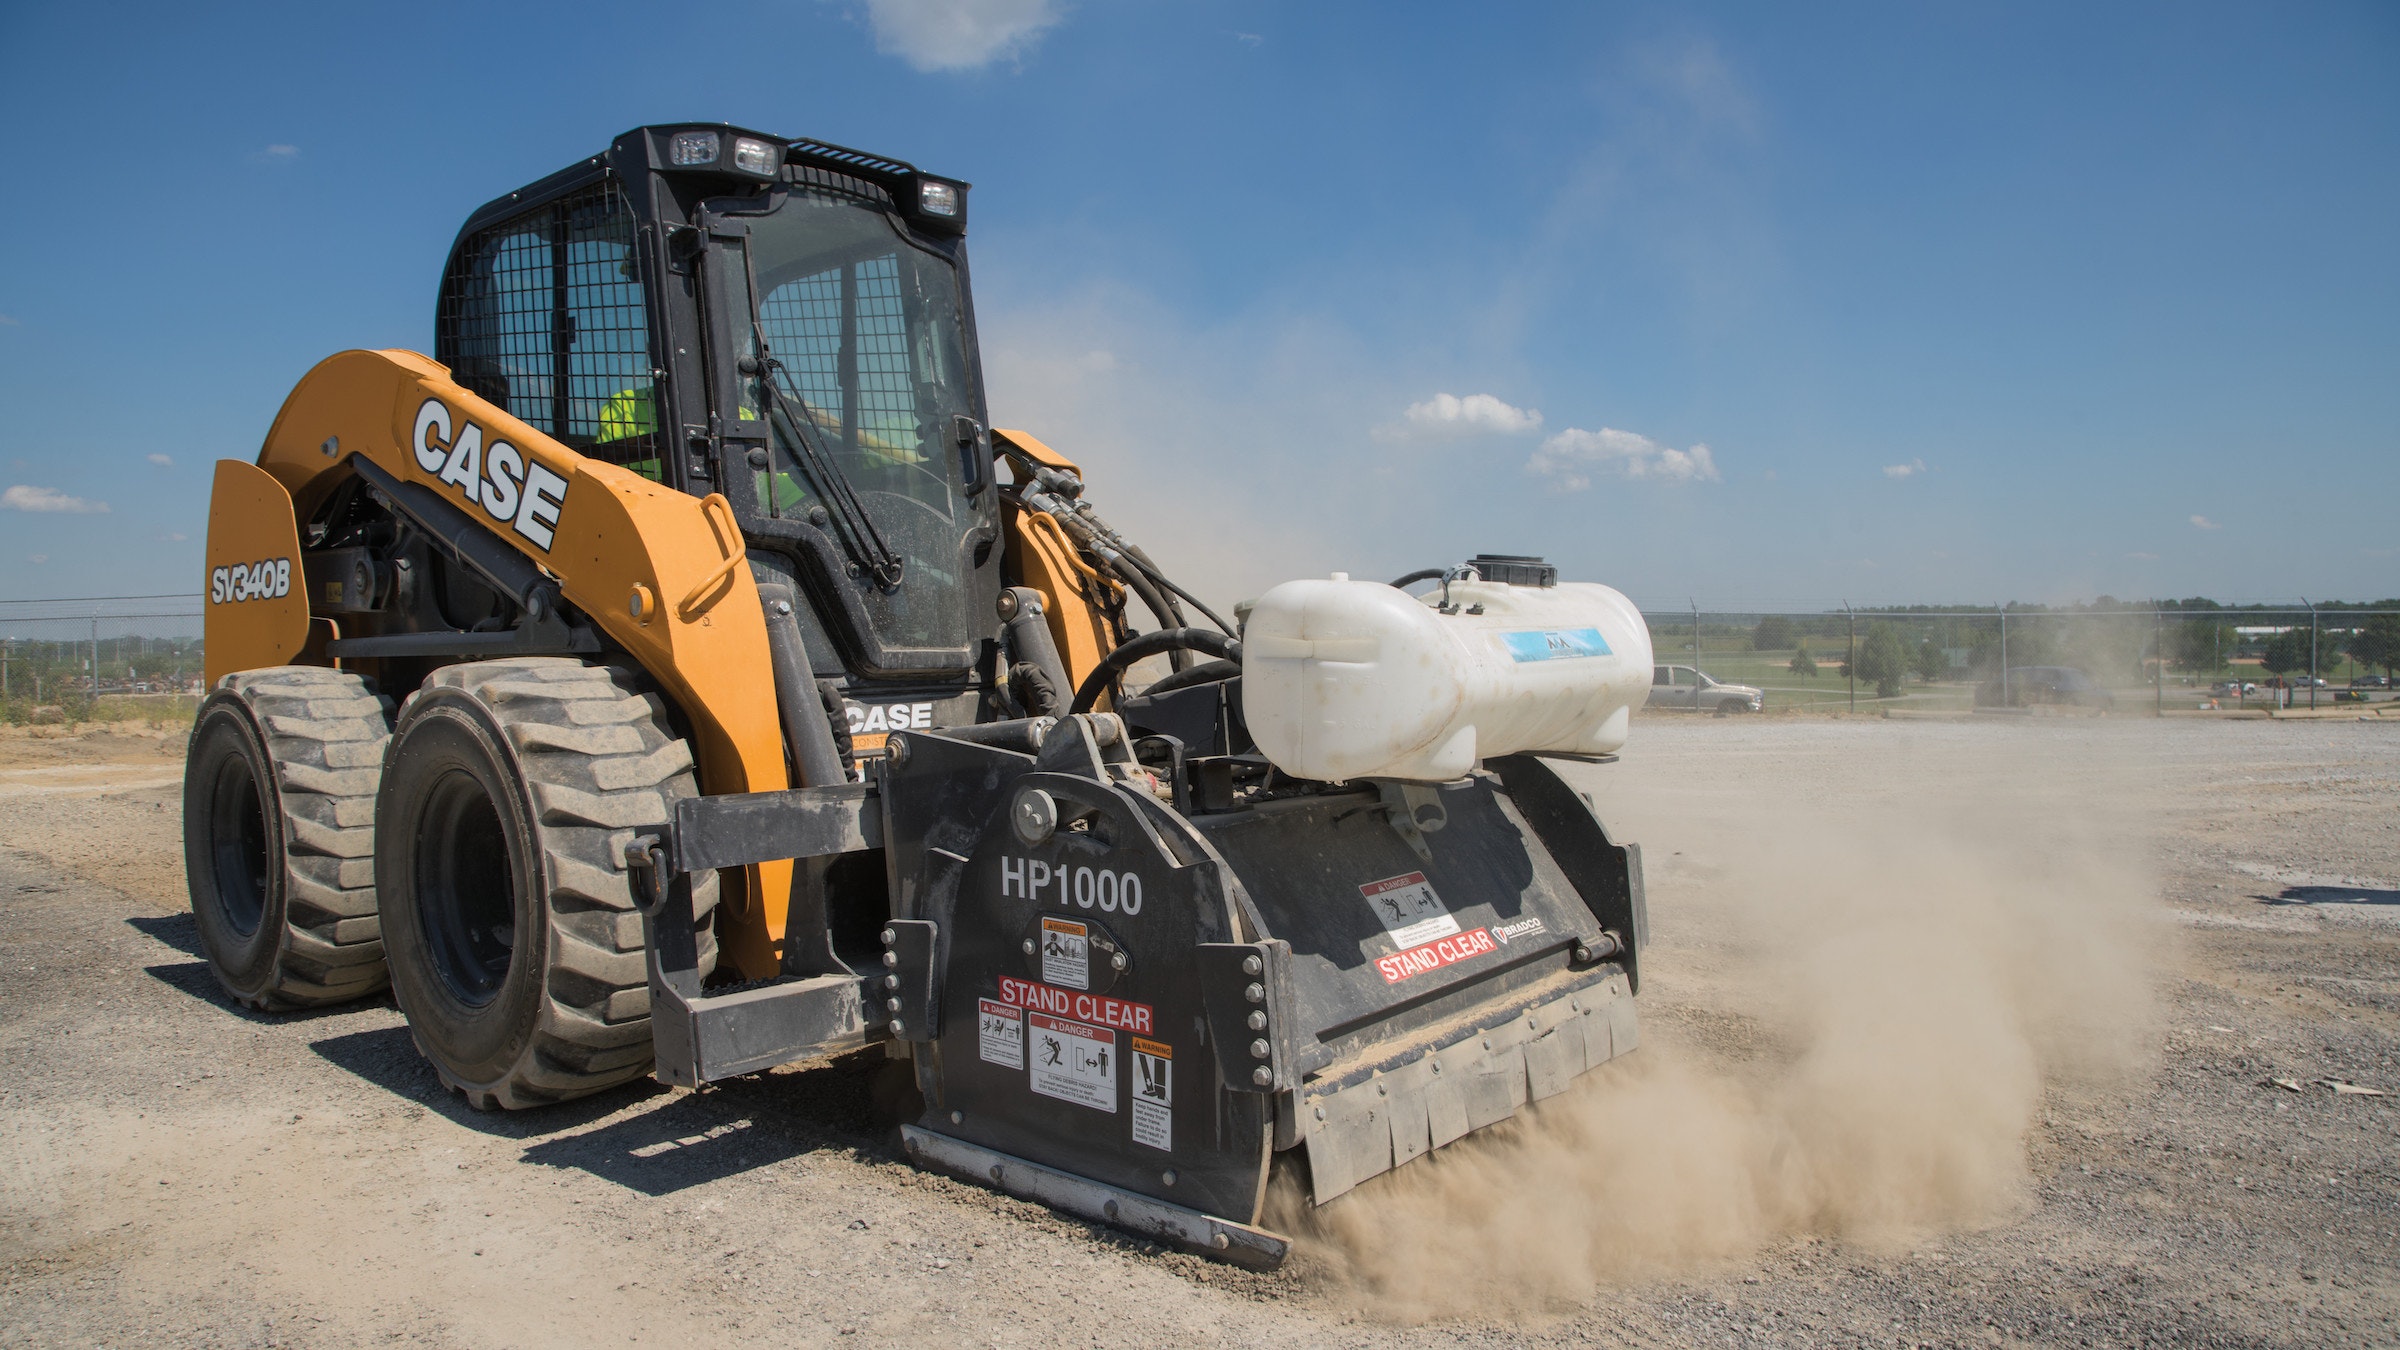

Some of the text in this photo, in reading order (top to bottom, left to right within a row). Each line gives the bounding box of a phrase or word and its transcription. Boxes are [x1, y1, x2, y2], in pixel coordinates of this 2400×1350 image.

[413, 397, 569, 554] CASE
[211, 558, 291, 605] SV340B
[845, 703, 932, 734] CASE
[853, 736, 888, 748] CONST
[1001, 856, 1143, 916] HP1000
[1383, 877, 1412, 890] DANGER
[1053, 923, 1081, 934] WARNING
[1503, 917, 1541, 936] BRADCO
[1380, 948, 1440, 980] STAND
[1438, 930, 1494, 963] CLEAR
[991, 1005, 1018, 1019] DANGER
[1002, 979, 1150, 1032] STAND CLEAR
[1059, 1022, 1094, 1038] DANGER
[1142, 1042, 1171, 1056] WARNING
